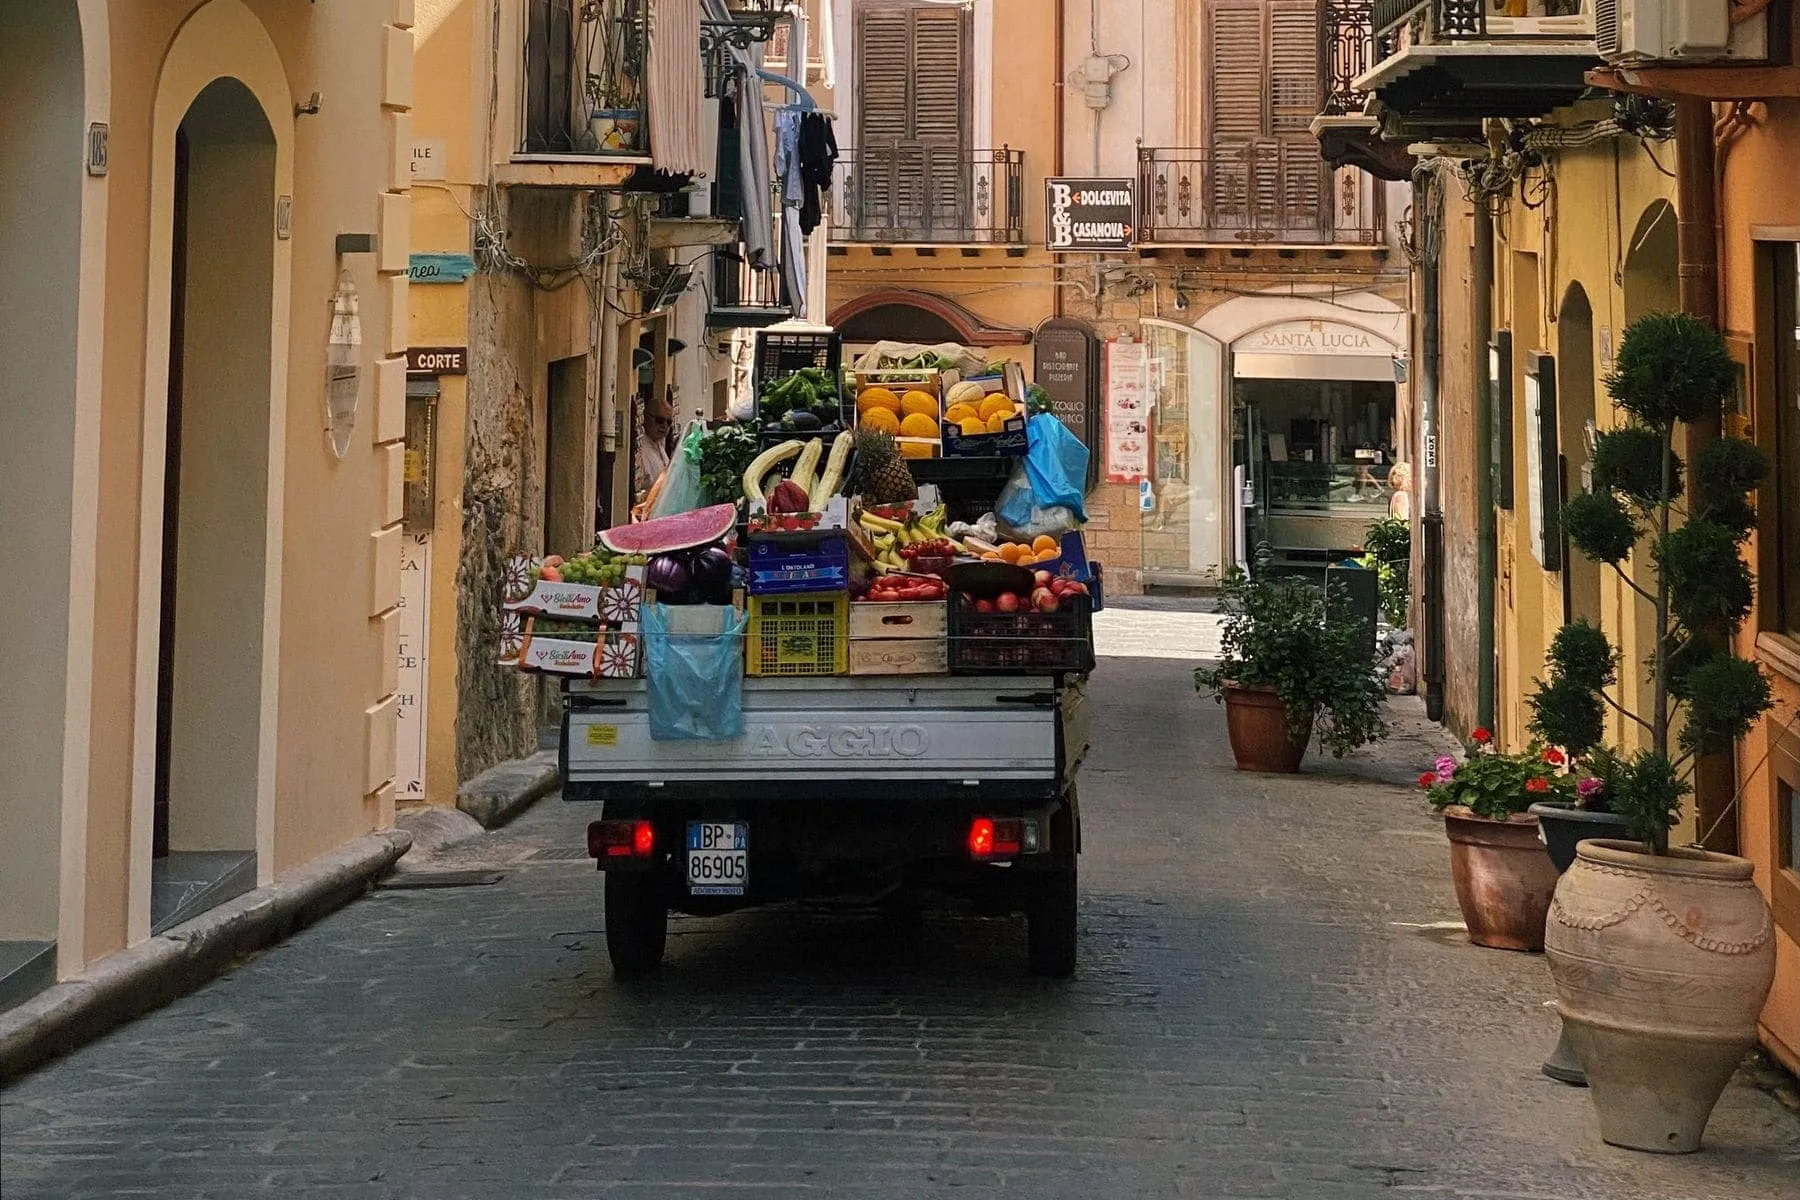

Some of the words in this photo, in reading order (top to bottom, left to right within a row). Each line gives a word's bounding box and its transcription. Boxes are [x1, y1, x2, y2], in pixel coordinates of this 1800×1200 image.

[1081, 190, 1131, 206] DOLCEVITA
[1073, 223, 1124, 238] CASANOVA
[1262, 331, 1315, 346] SANTA
[1321, 332, 1371, 348] LUCIA
[418, 354, 461, 369] CORTE
[703, 825, 724, 848] BP
[691, 855, 745, 879] 86905
